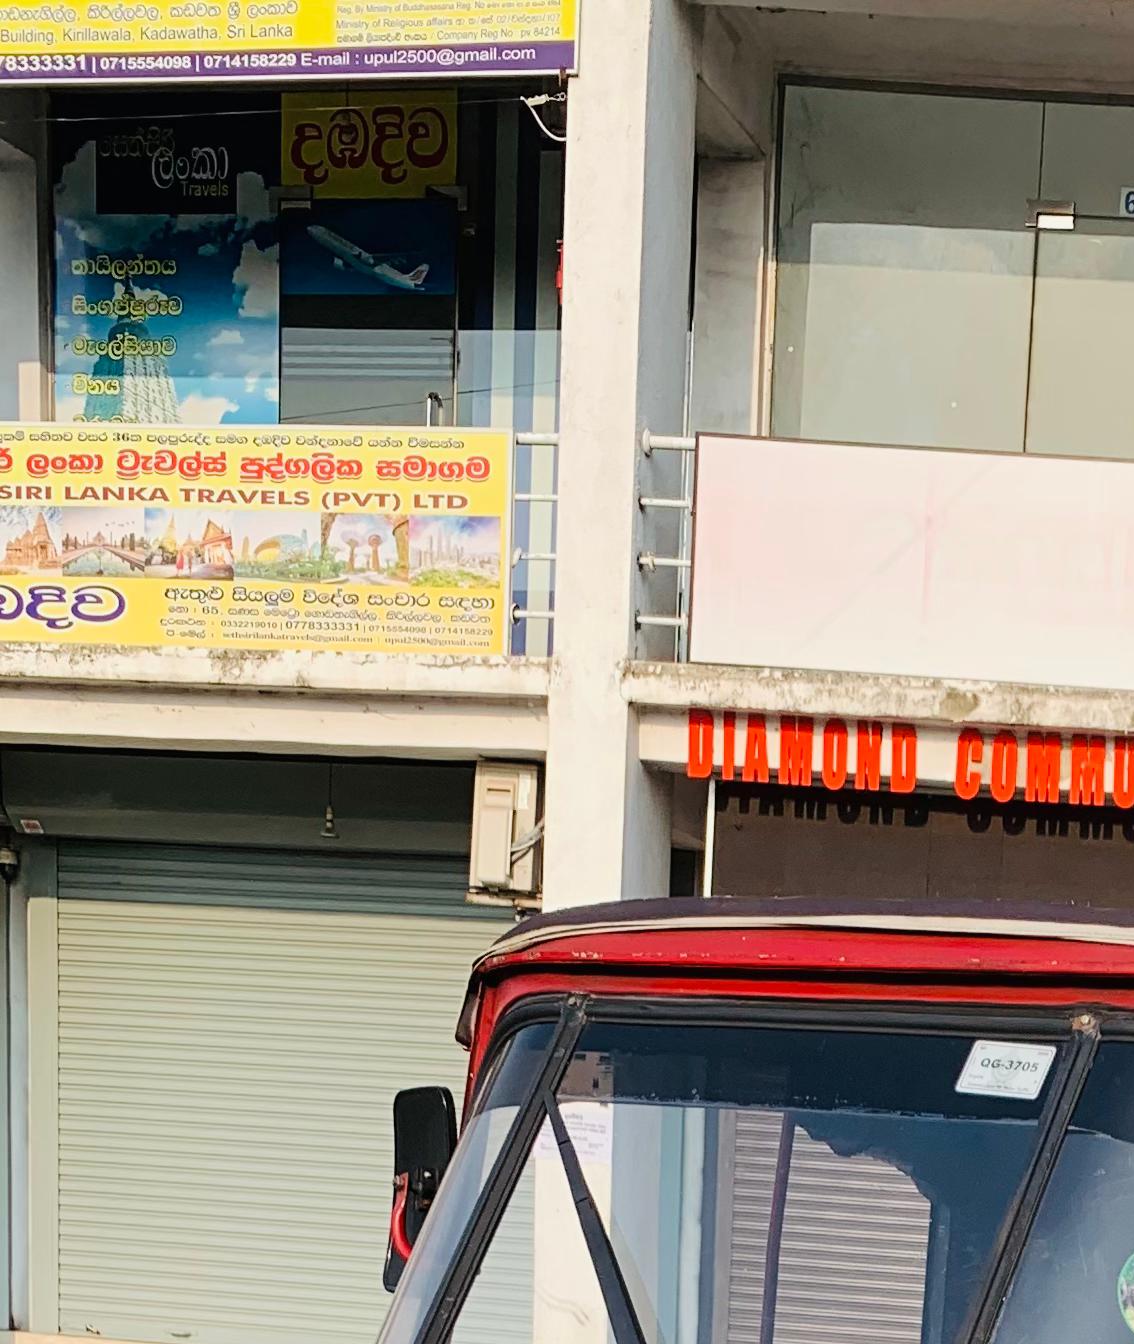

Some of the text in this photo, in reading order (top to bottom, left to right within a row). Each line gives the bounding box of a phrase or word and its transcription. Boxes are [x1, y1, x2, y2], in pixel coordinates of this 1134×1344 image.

[1, 24, 293, 46] Building, Kirillawala, Kadawatha, Sri Lanka
[336, 18, 370, 31] Ministry
[372, 18, 383, 28] of
[384, 16, 424, 29] Religious
[437, 29, 480, 42] Company
[100, 56, 192, 70] 0715554098
[203, 53, 296, 68] 0714158229
[301, 51, 350, 66] E-mail
[364, 47, 536, 67] upul2500@gmail.com
[291, 105, 449, 185] දඹදිව
[152, 147, 229, 189] ලංකා
[181, 180, 229, 197] Travels
[26, 453, 104, 477] ලංකා
[376, 455, 490, 482] සමාගම
[0, 485, 468, 512] SIRI LANKA TRAVELS (PVT) LTD
[686, 707, 918, 794] DIAMOND
[981, 1058, 1039, 1073] QG-3705
